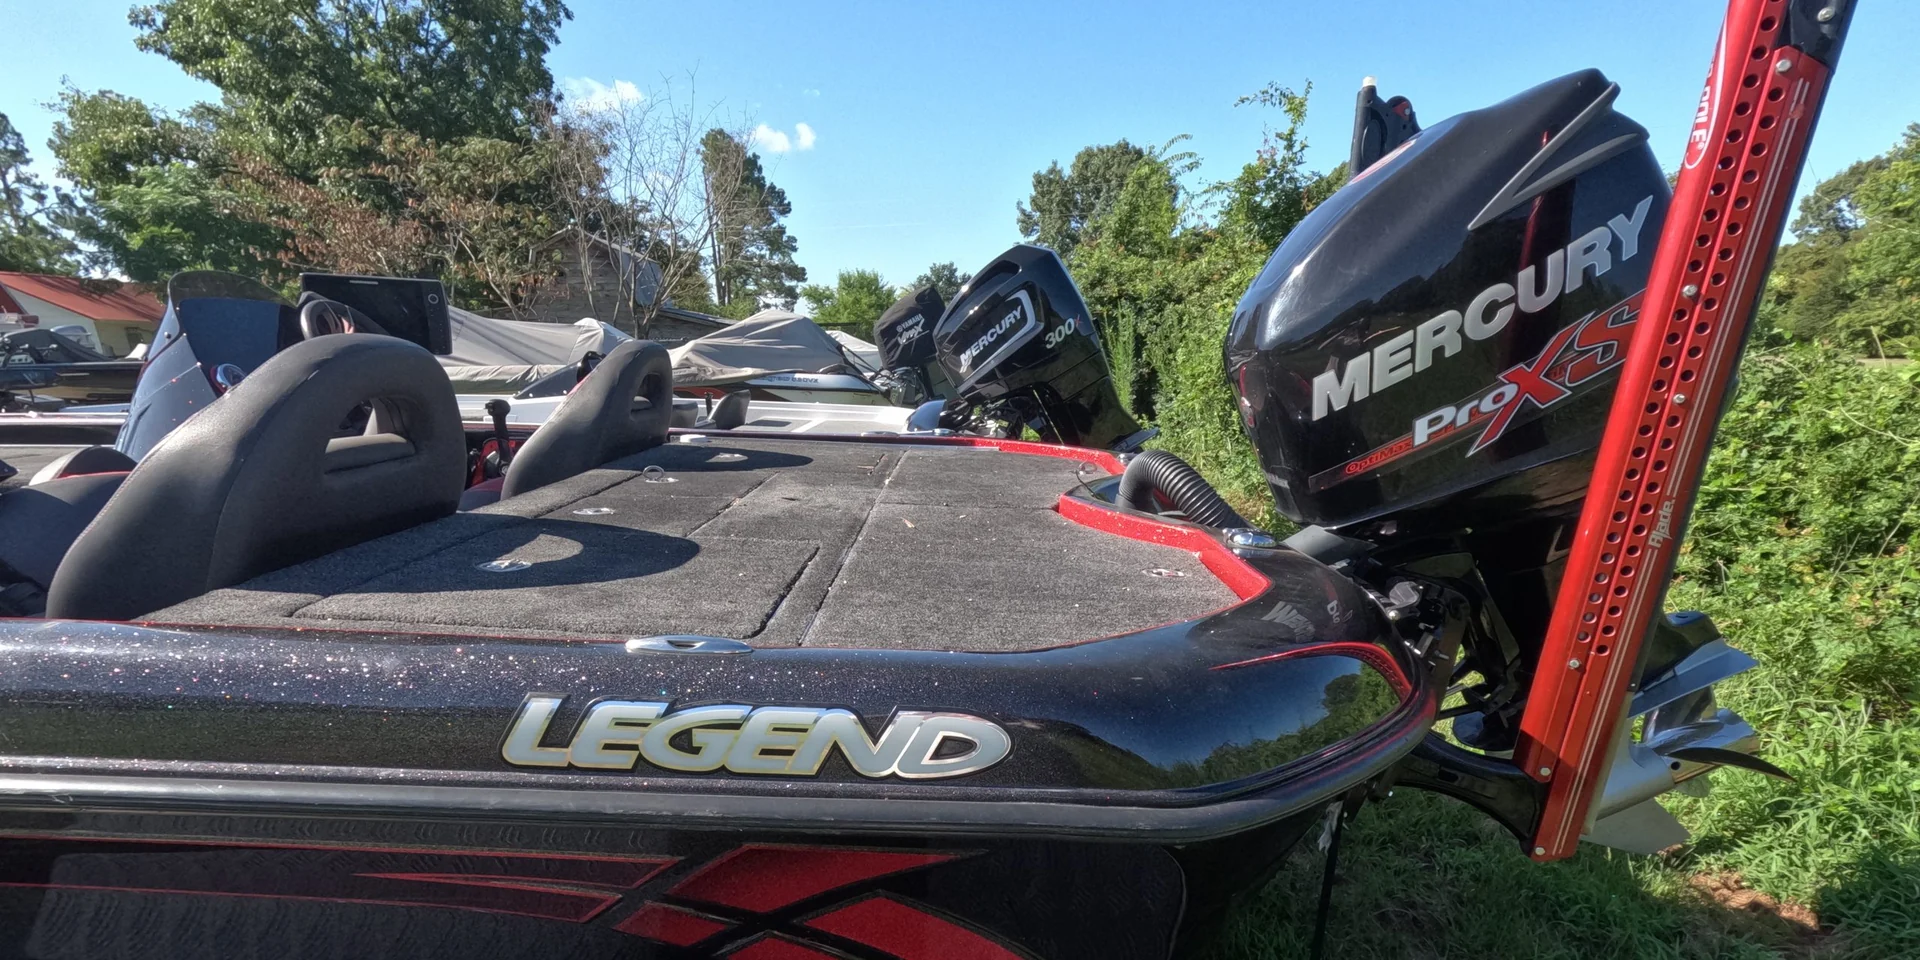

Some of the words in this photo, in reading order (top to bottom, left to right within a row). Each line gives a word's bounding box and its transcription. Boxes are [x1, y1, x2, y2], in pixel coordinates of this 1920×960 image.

[901, 313, 924, 329] YAMAHA
[959, 305, 1022, 373] MERCURY
[1312, 195, 1654, 421] MERCURY
[502, 695, 1013, 780] LEGEND
